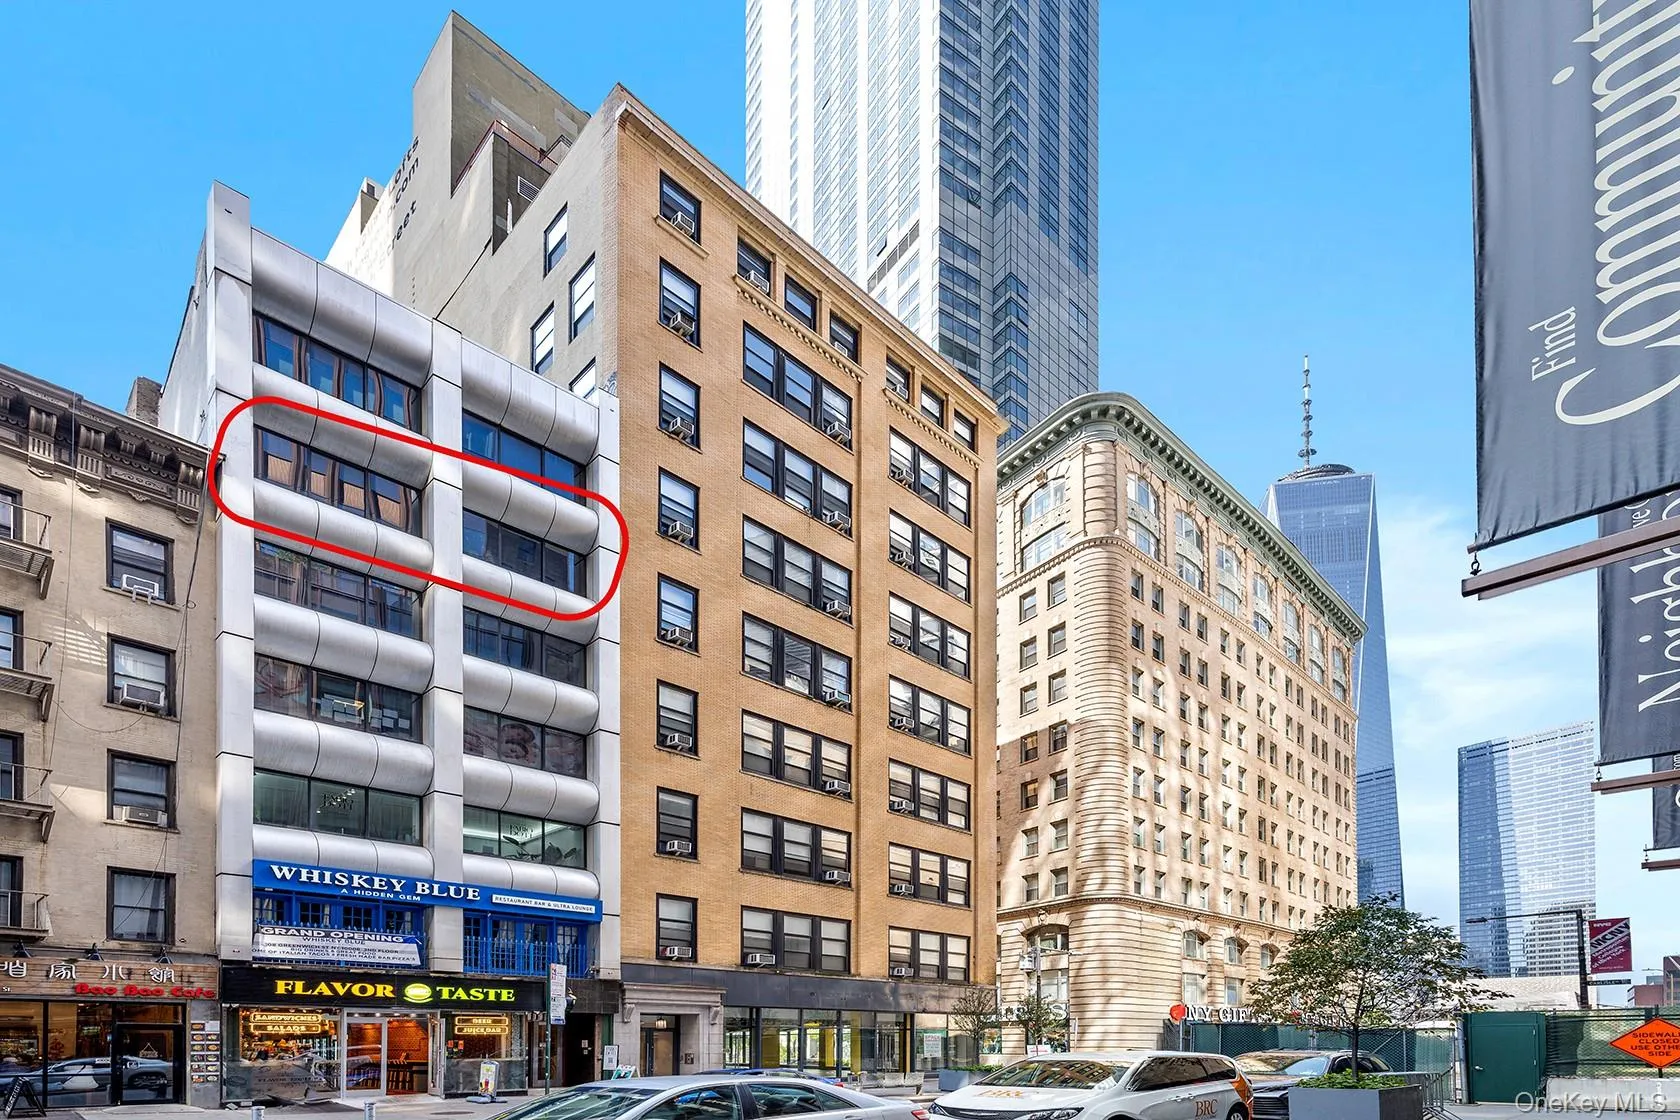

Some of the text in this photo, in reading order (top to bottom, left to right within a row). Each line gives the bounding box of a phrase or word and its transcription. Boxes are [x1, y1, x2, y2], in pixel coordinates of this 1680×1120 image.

[1551, 0, 1680, 426] Communit
[1531, 306, 1576, 382] Find
[270, 864, 481, 900] WHISKEY BLUE
[354, 889, 394, 898] HIDDEN
[494, 896, 532, 905] RESTAURANT
[261, 927, 404, 943] GRAND OPENING
[1590, 921, 1630, 949] MCNY
[275, 980, 396, 998] FLAVOR
[436, 986, 516, 1002] TASTE
[254, 1013, 319, 1022] SANDWICHES
[1182, 1003, 1213, 1021] NY
[1195, 1099, 1218, 1118] BRC
